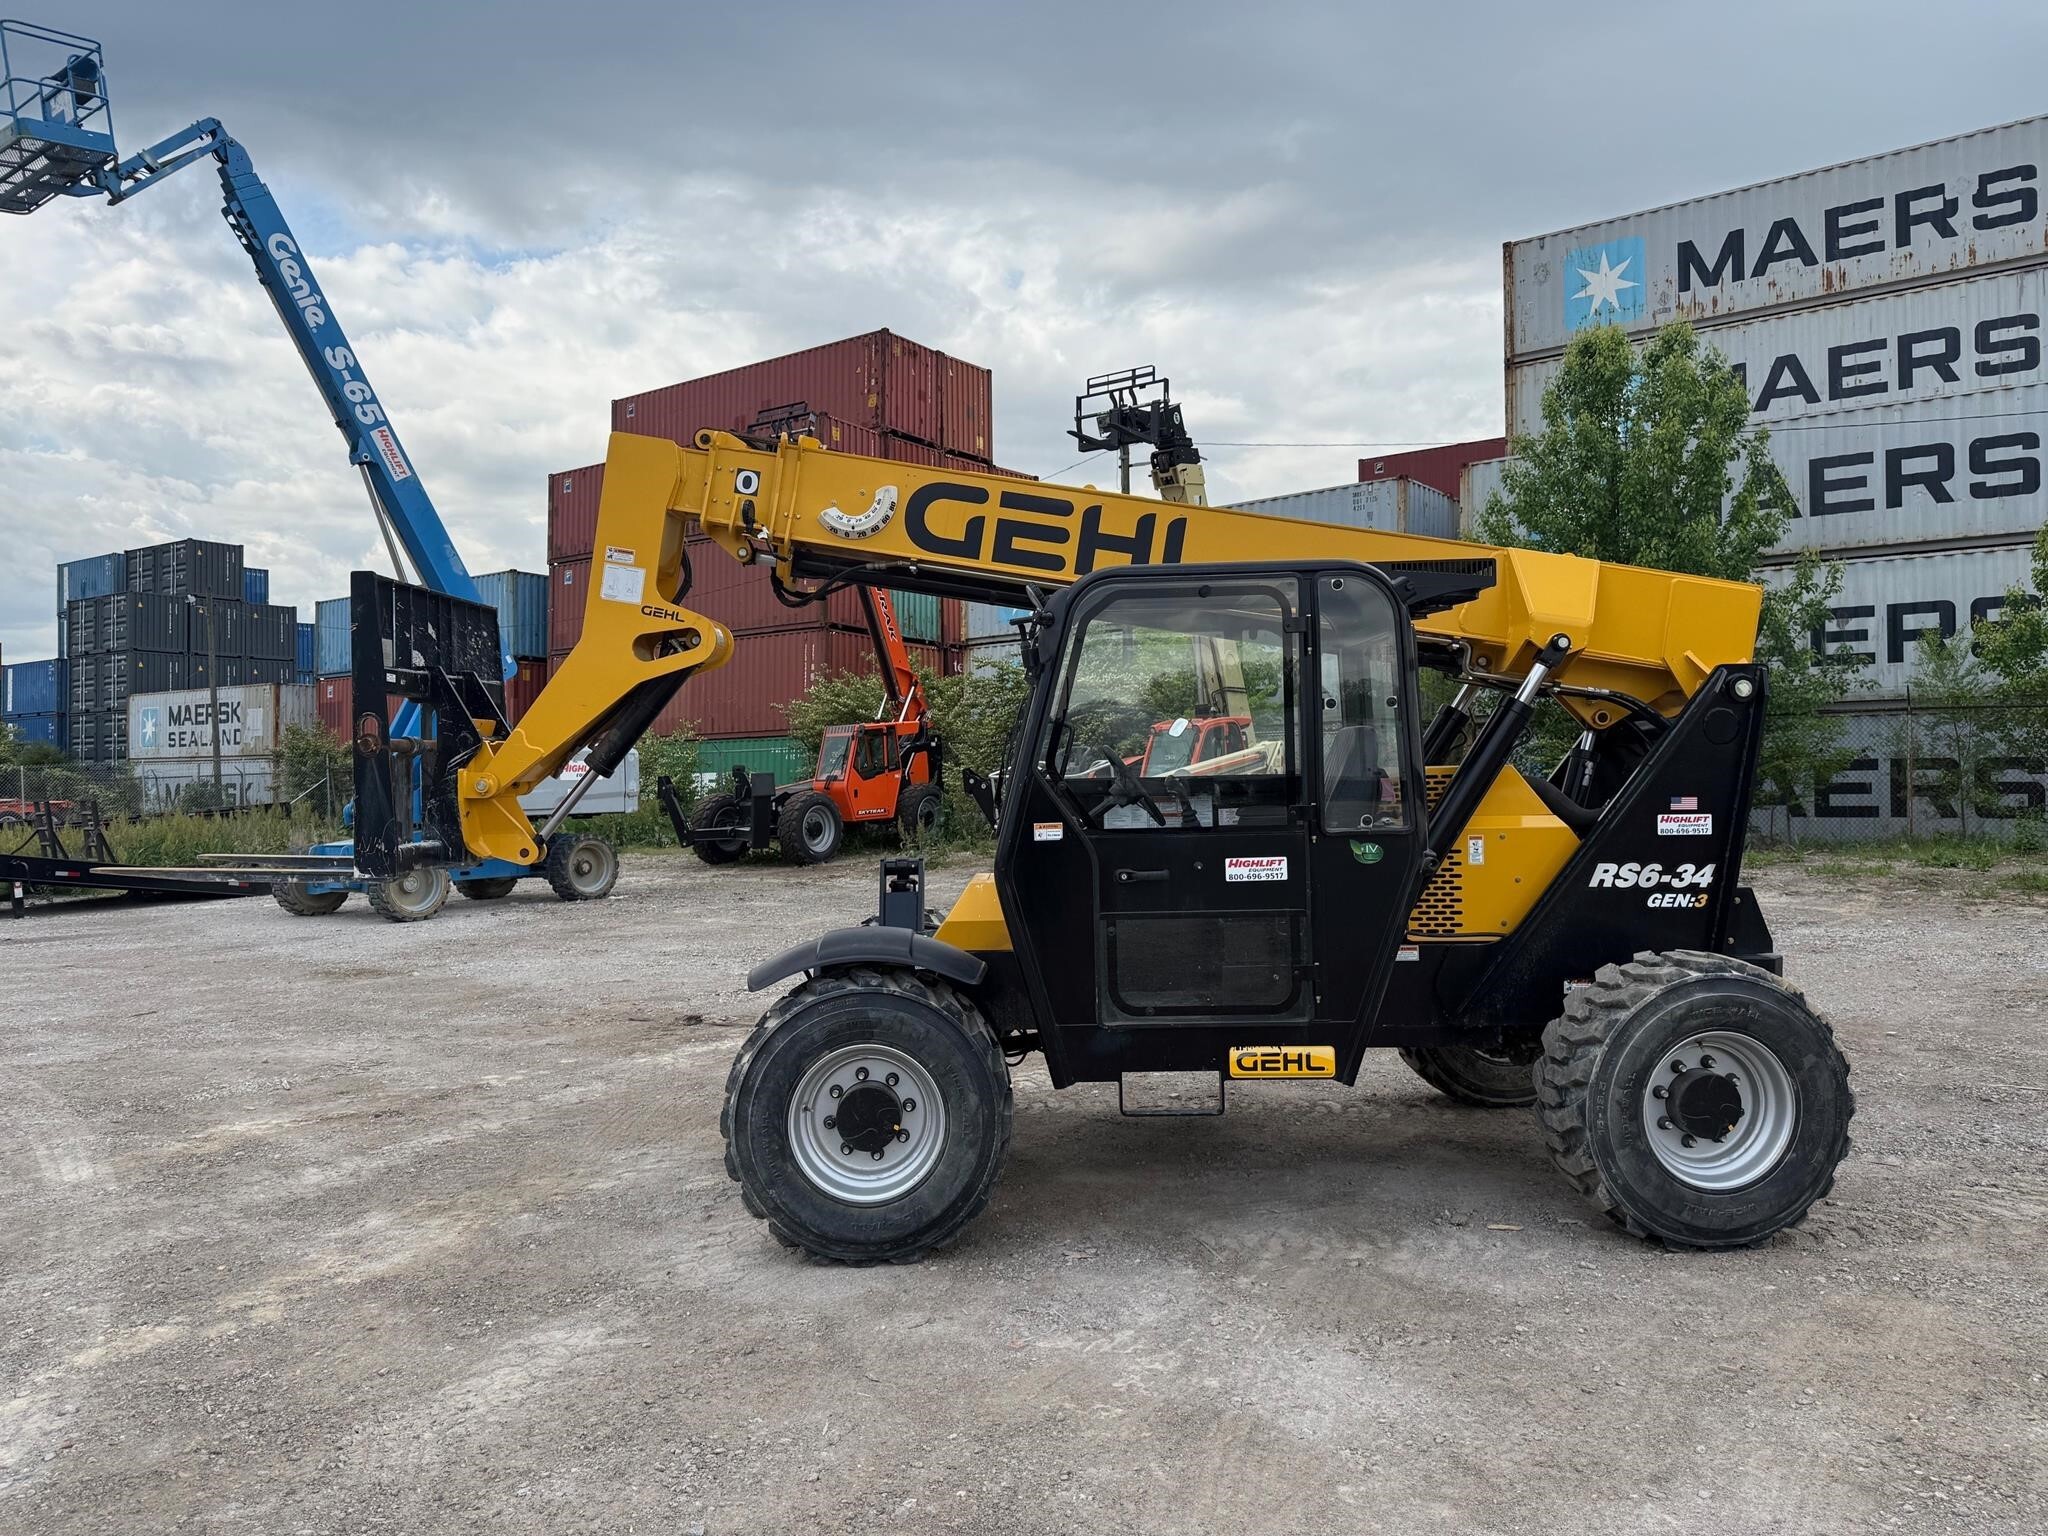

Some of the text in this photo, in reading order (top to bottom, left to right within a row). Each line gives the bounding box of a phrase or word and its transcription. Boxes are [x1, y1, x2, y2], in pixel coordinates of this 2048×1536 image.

[1676, 164, 2039, 294] MAERS
[267, 232, 386, 425] Genie S-65
[1731, 313, 2042, 413] AERS
[377, 428, 408, 477] HIGHLIFT
[857, 530, 867, 538] 20
[870, 524, 880, 533] 40
[881, 514, 891, 525] 60
[888, 501, 896, 512] 80
[641, 605, 686, 623] GEHL
[168, 728, 241, 748] SEALND
[1660, 815, 1710, 824] HIGHLIFT
[1228, 858, 1285, 868] HIGHLIFT
[1228, 872, 1284, 881] 800-696-9517
[1588, 862, 1717, 888] RS6-34
[1647, 893, 1709, 908] GEN:3
[1236, 1052, 1326, 1072] GEHL
